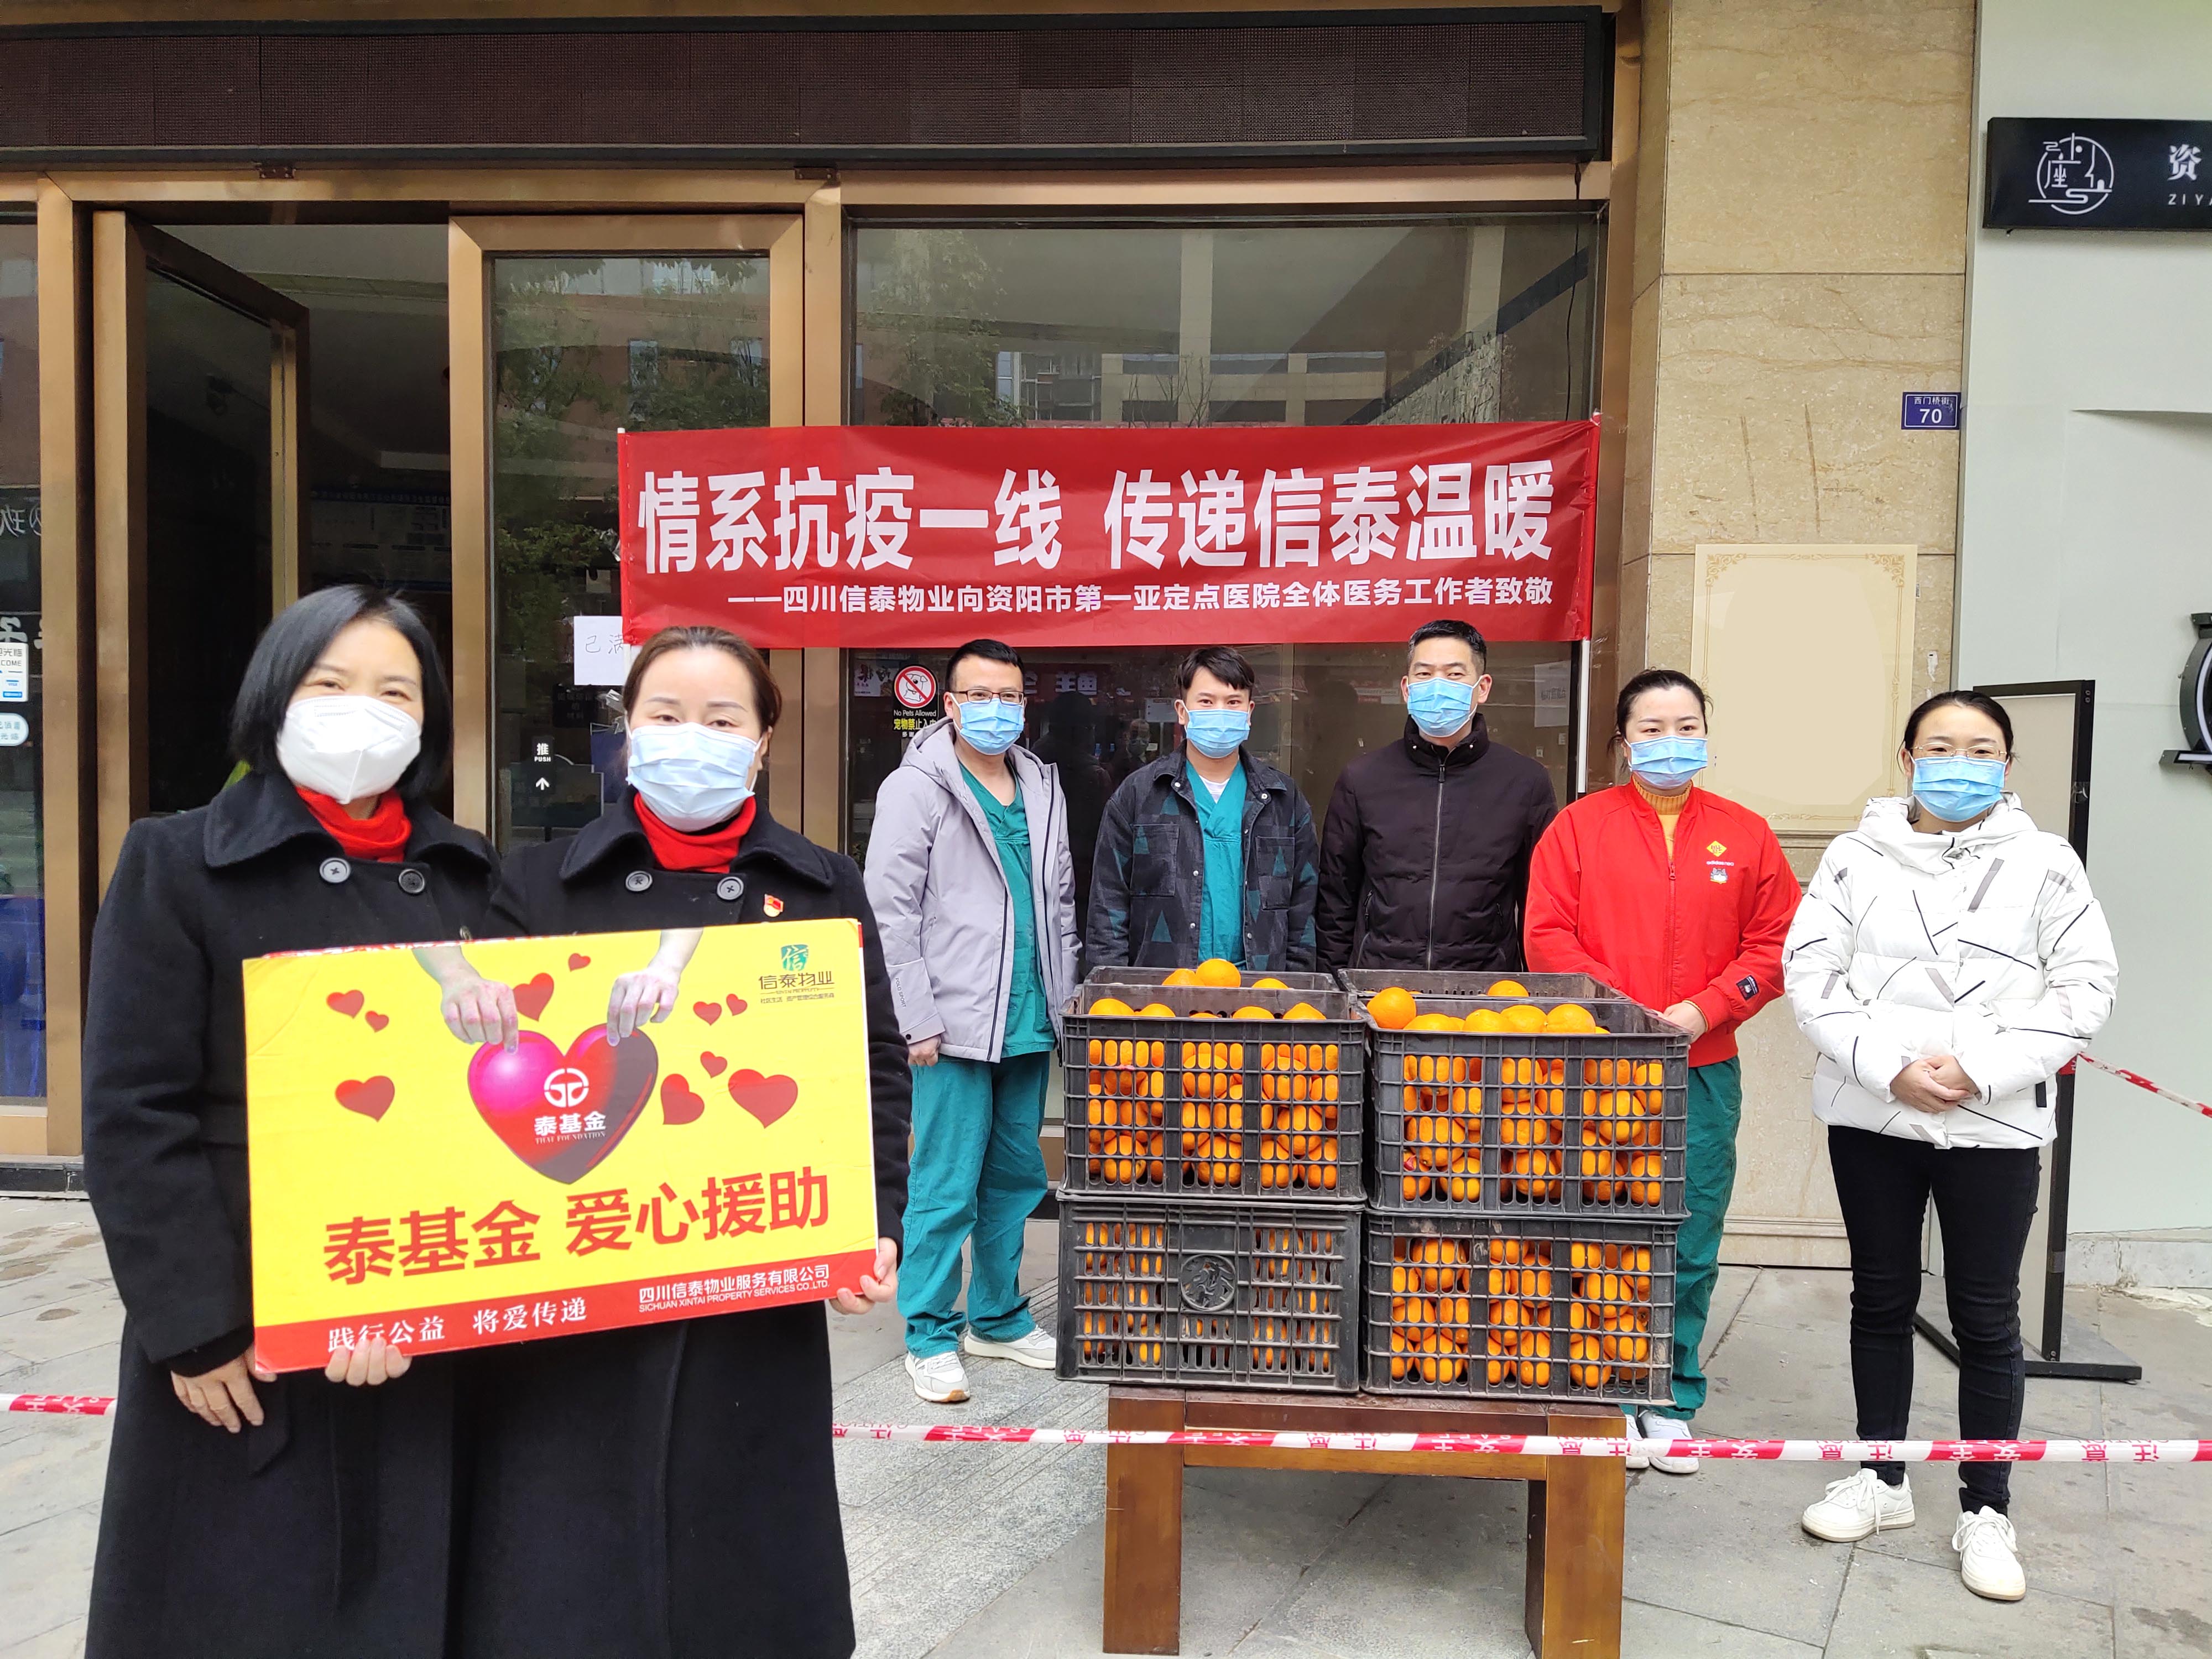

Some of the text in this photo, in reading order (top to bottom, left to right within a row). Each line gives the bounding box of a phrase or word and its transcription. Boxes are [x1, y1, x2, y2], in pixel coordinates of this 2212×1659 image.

[2167, 144, 2202, 181] 资
[1914, 396, 1950, 405] 西门桥街
[1919, 408, 1942, 424] 70
[638, 460, 1554, 575] 情系抗疫一线 传递信泰温暖
[536, 743, 550, 756] 推
[758, 971, 835, 990] 信泰物业
[899, 992, 907, 1008] SPORT
[534, 1110, 607, 1136] 泰基金
[557, 1131, 607, 1142] FOUNDATION
[324, 1166, 830, 1286] 泰基金 爱心援助
[639, 1264, 830, 1303] 四川信泰物业服务有限公司
[639, 1301, 677, 1313] SICHUAN
[679, 1297, 706, 1307] XINTAI
[707, 1291, 753, 1304] PROPERTY
[754, 1284, 796, 1298] SERVICES
[328, 1296, 588, 1353] 践行公益 将爱传递
